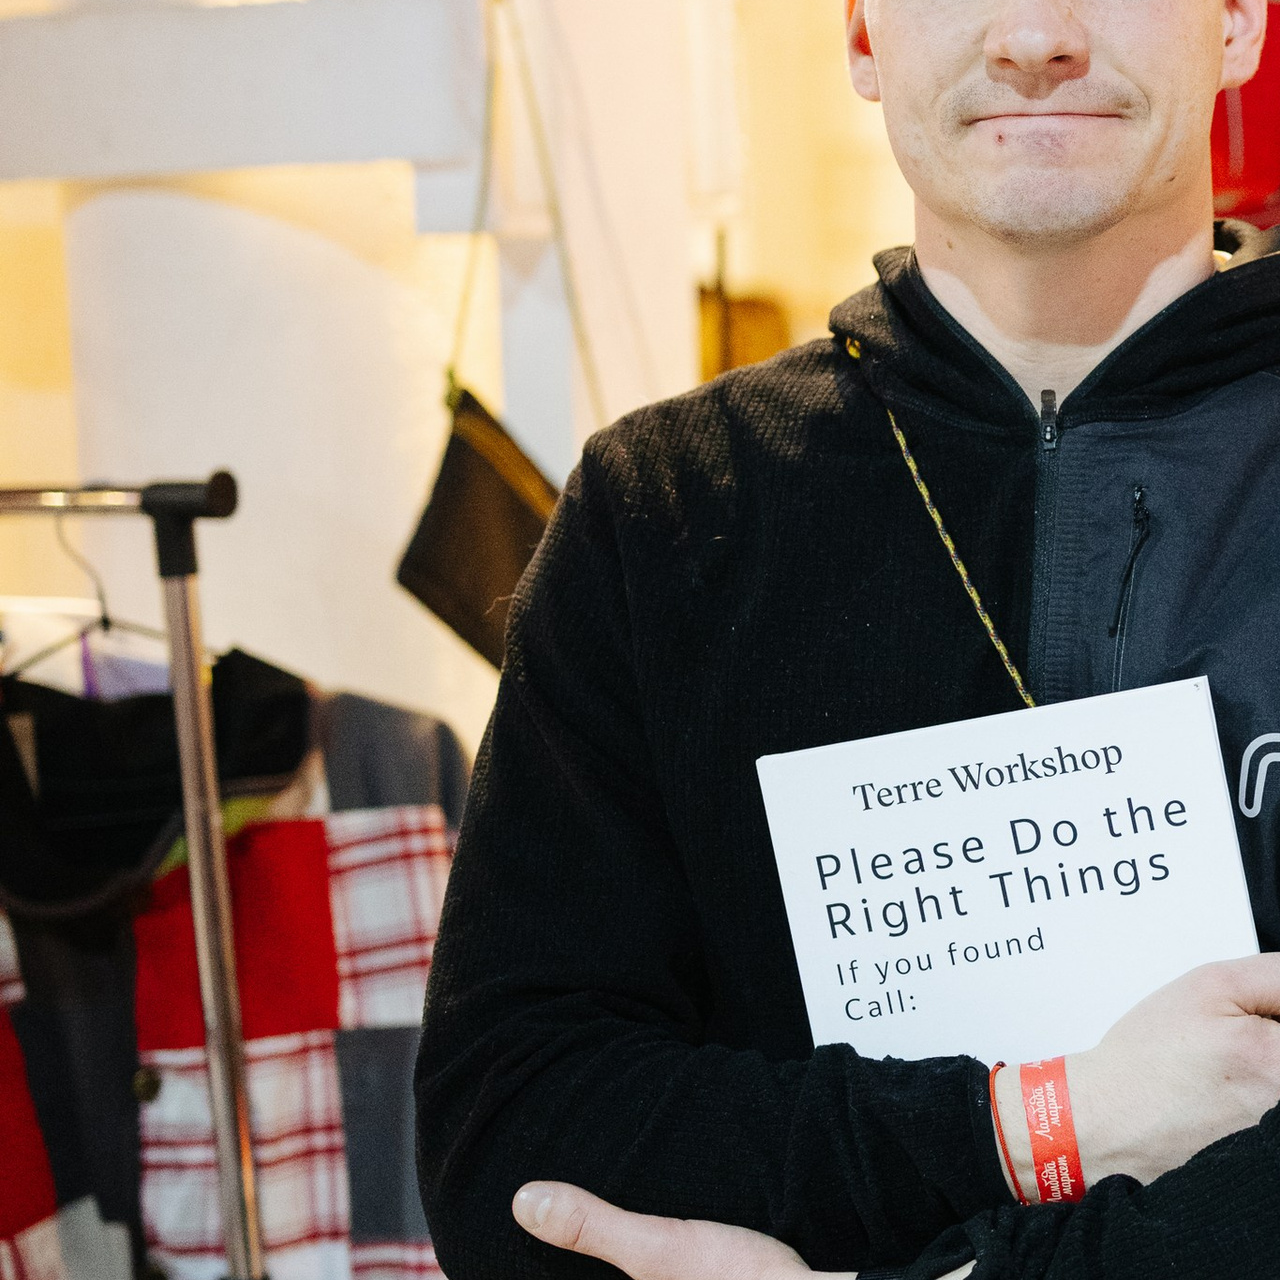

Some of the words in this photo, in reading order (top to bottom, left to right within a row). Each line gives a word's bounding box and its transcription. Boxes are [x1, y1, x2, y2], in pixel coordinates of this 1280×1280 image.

[852, 778, 944, 811] Terre
[947, 745, 1123, 793] Workshop
[815, 836, 986, 891] Please
[1009, 818, 1079, 856] Do
[1102, 797, 1189, 838] the
[825, 886, 969, 939] Right
[988, 853, 1171, 908] Things
[836, 959, 859, 986] If
[874, 953, 934, 985] you
[947, 926, 1046, 967] found
[844, 989, 918, 1022] Call:
[1028, 1086, 1054, 1141] Ламбада
[1045, 1079, 1063, 1127] маркет
[1057, 1154, 1076, 1196] маркет
